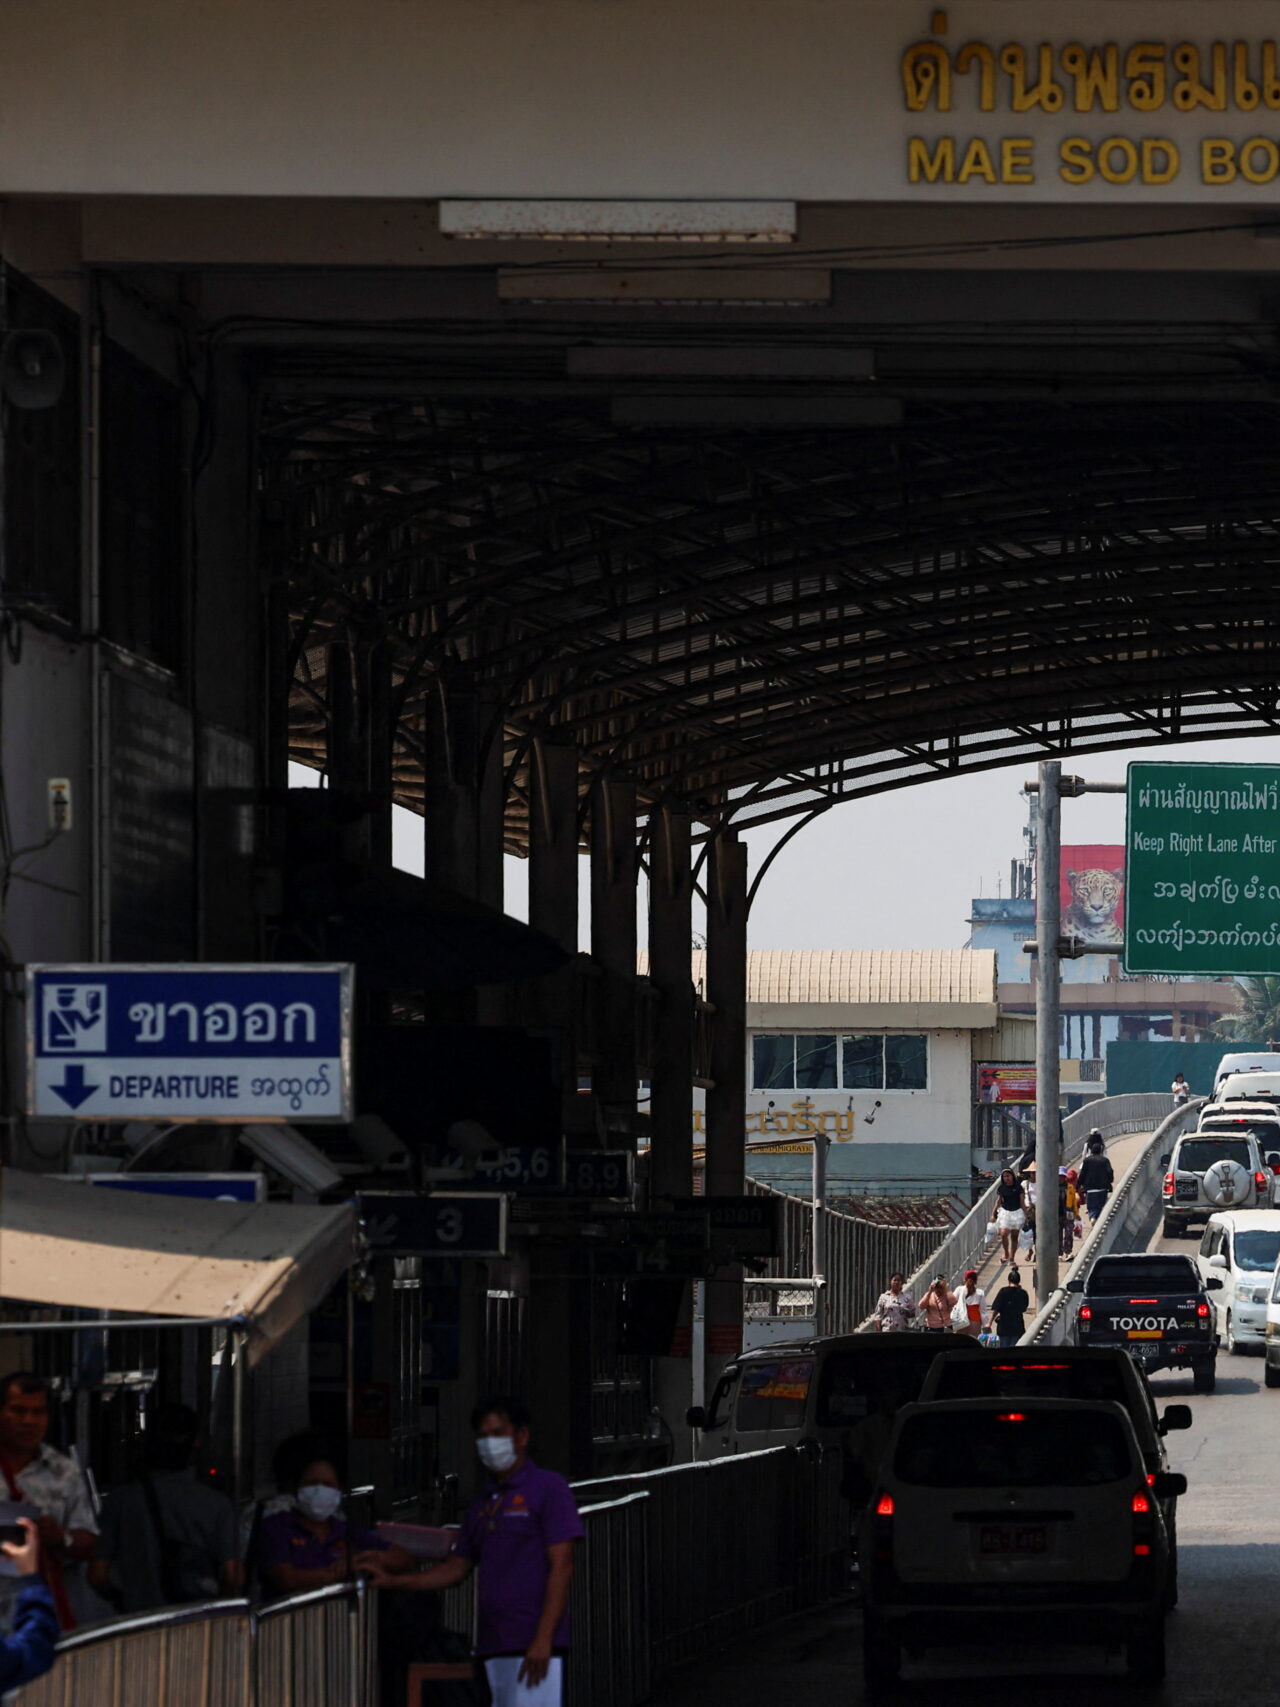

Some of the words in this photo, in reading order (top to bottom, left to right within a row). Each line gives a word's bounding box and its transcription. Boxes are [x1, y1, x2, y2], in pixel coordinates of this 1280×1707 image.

[908, 137, 1036, 184] MAE
[1059, 137, 1182, 185] SOD
[1133, 831, 1164, 857] Keep
[1170, 832, 1203, 857] Right
[1207, 833, 1238, 853] Lane
[1242, 833, 1277, 854] After
[128, 1002, 317, 1042] ขาออก
[109, 1075, 239, 1099] DEPARTURE
[434, 1206, 465, 1242] 3
[1109, 1317, 1180, 1332] TOYOTA
